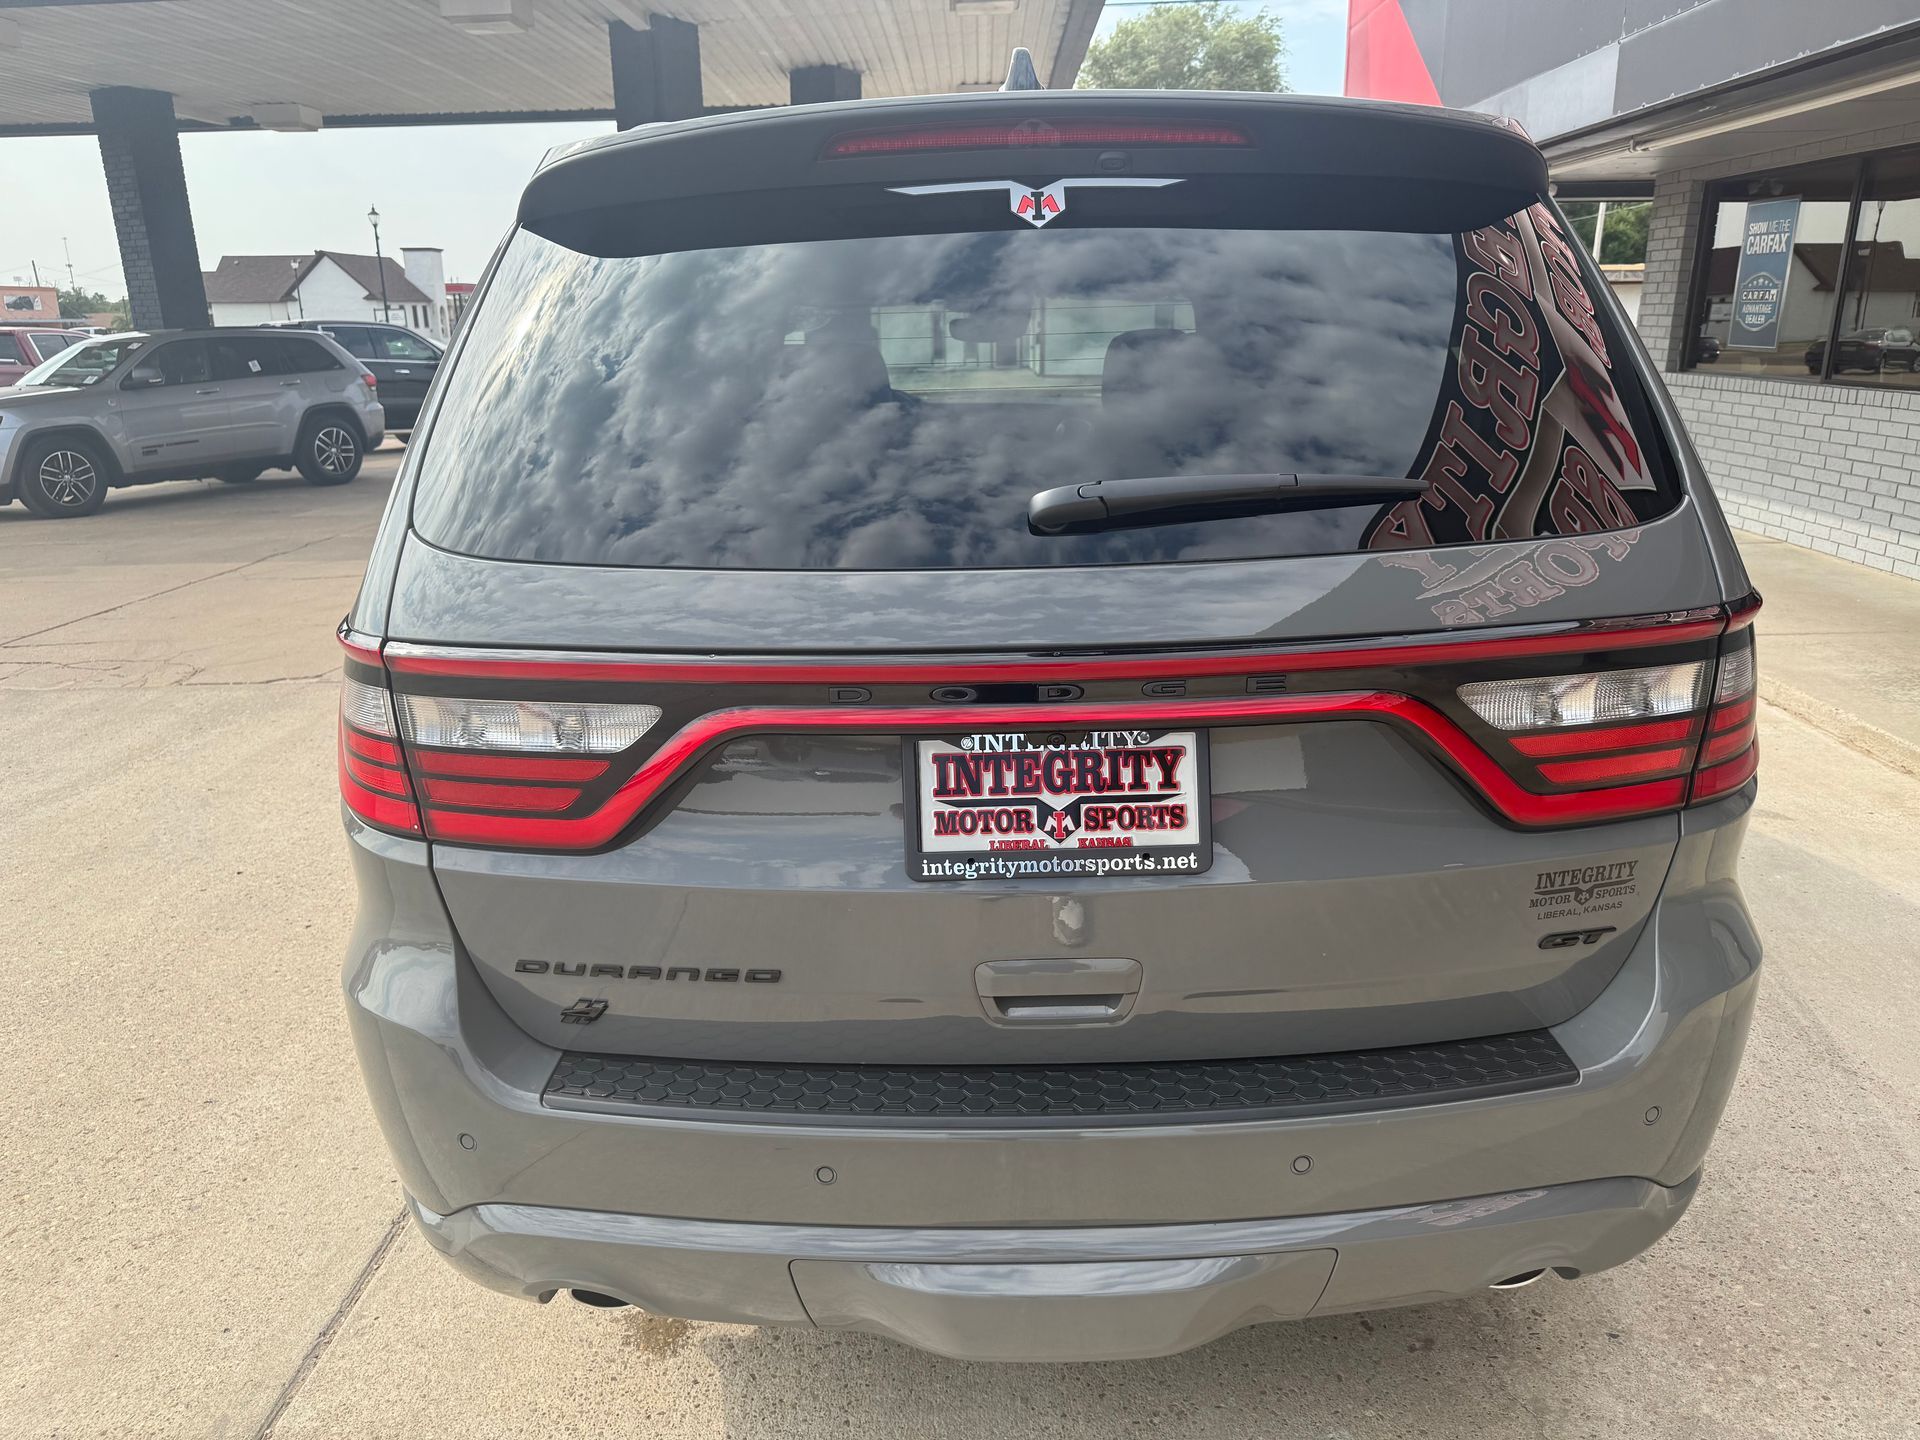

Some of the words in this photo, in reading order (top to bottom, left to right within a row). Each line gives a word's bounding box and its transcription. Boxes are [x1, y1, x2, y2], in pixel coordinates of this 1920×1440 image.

[1749, 222, 1768, 234] SHOW
[1767, 220, 1779, 233] ME
[1779, 218, 1791, 231] THE
[1746, 233, 1790, 254] CARFAX
[1742, 304, 1772, 313] ADVANTAGE
[828, 674, 1287, 704] DODGE
[932, 747, 1187, 798] INTEGRITY
[933, 806, 1036, 836] MOTOR
[1083, 804, 1187, 832] SPORTS
[1076, 836, 1134, 849] KANSAS
[921, 852, 1199, 879] integritymotorsports.net
[1534, 860, 1639, 890] INTEGRITY
[1529, 894, 1571, 908] MOTOR
[1595, 885, 1636, 899] SPORTS
[1536, 908, 1582, 920] LIBERAL,
[1582, 901, 1623, 914] KANSAS
[1537, 925, 1617, 950] GT
[514, 959, 782, 983] DURANGO
